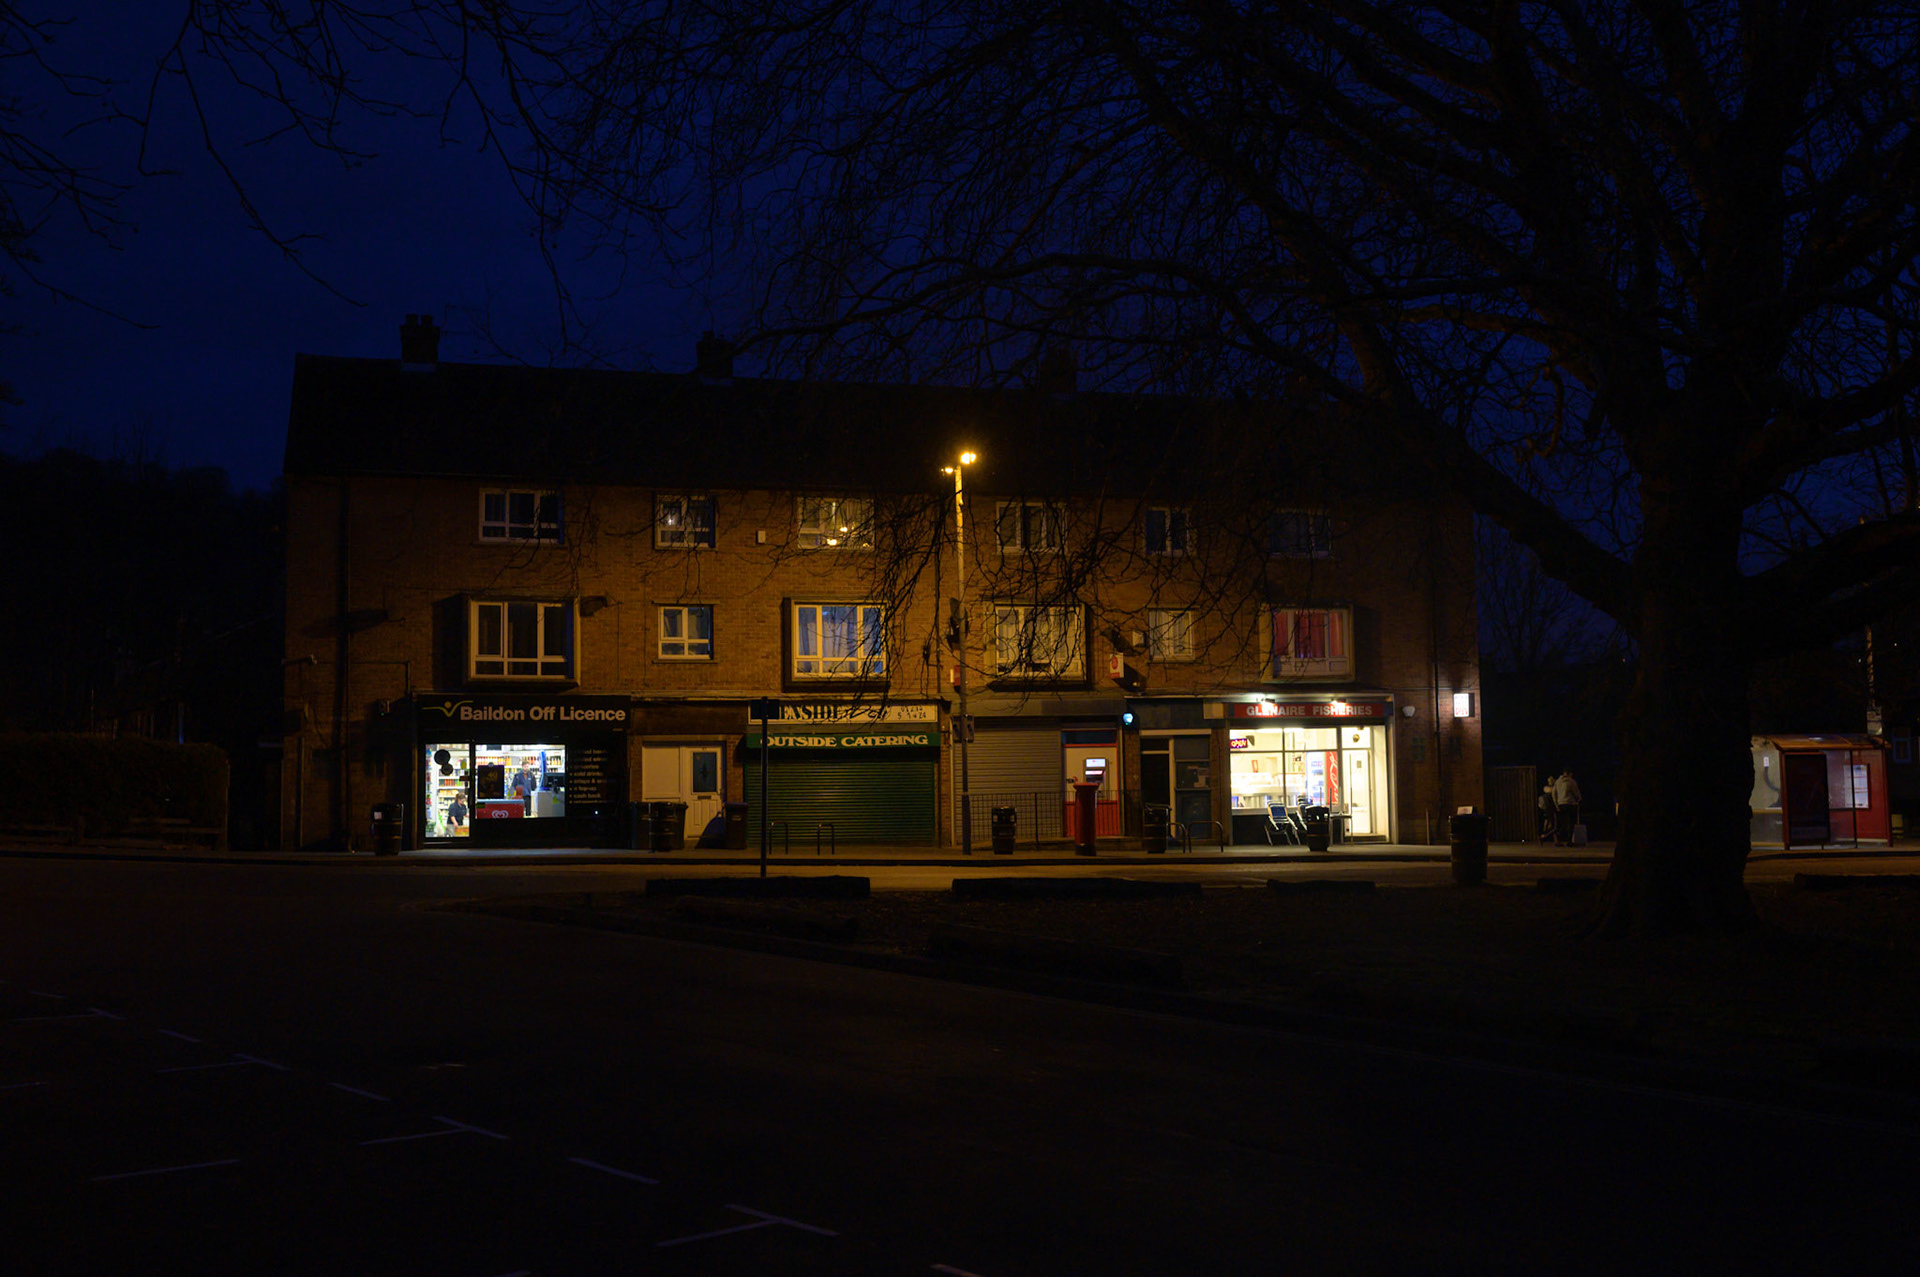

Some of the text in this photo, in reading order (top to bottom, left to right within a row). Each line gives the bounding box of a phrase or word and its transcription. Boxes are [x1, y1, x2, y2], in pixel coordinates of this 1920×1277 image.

[460, 706, 626, 721] Baildon Off Licence
[780, 704, 843, 719] ENSIDE
[1246, 705, 1373, 716] GLENAIRE FISHERIES
[759, 735, 928, 748] OUTSIDE CATERING
